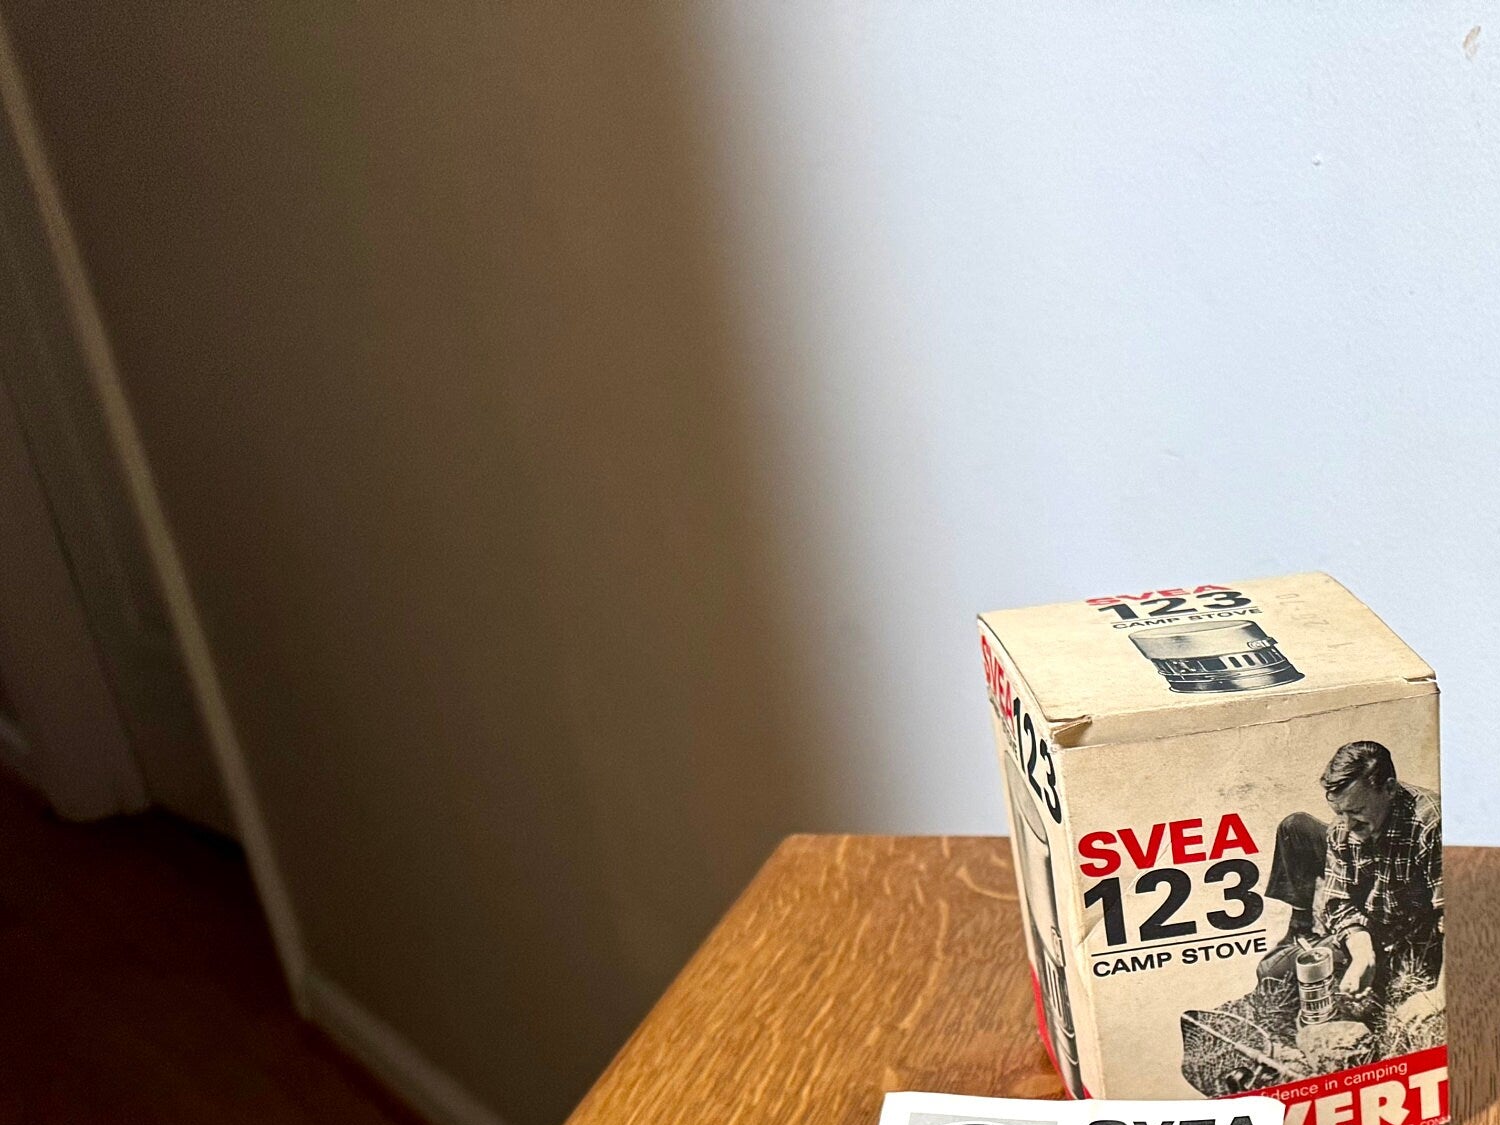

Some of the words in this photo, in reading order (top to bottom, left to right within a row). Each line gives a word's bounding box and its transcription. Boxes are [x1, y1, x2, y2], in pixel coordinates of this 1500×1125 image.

[1085, 584, 1231, 606] SVEA
[1097, 591, 1252, 620] 123
[1112, 616, 1180, 630] CAMP
[1187, 607, 1263, 621] STOVE
[981, 635, 1016, 738] SVEA
[1013, 696, 1063, 825] 123
[1078, 813, 1260, 877] SVEA
[1083, 858, 1265, 947] 123
[1092, 951, 1173, 978] CAMP
[1181, 936, 1268, 965] STOVE
[1261, 1083, 1320, 1102] dence
[1324, 1077, 1339, 1092] in
[1343, 1061, 1409, 1088] camping
